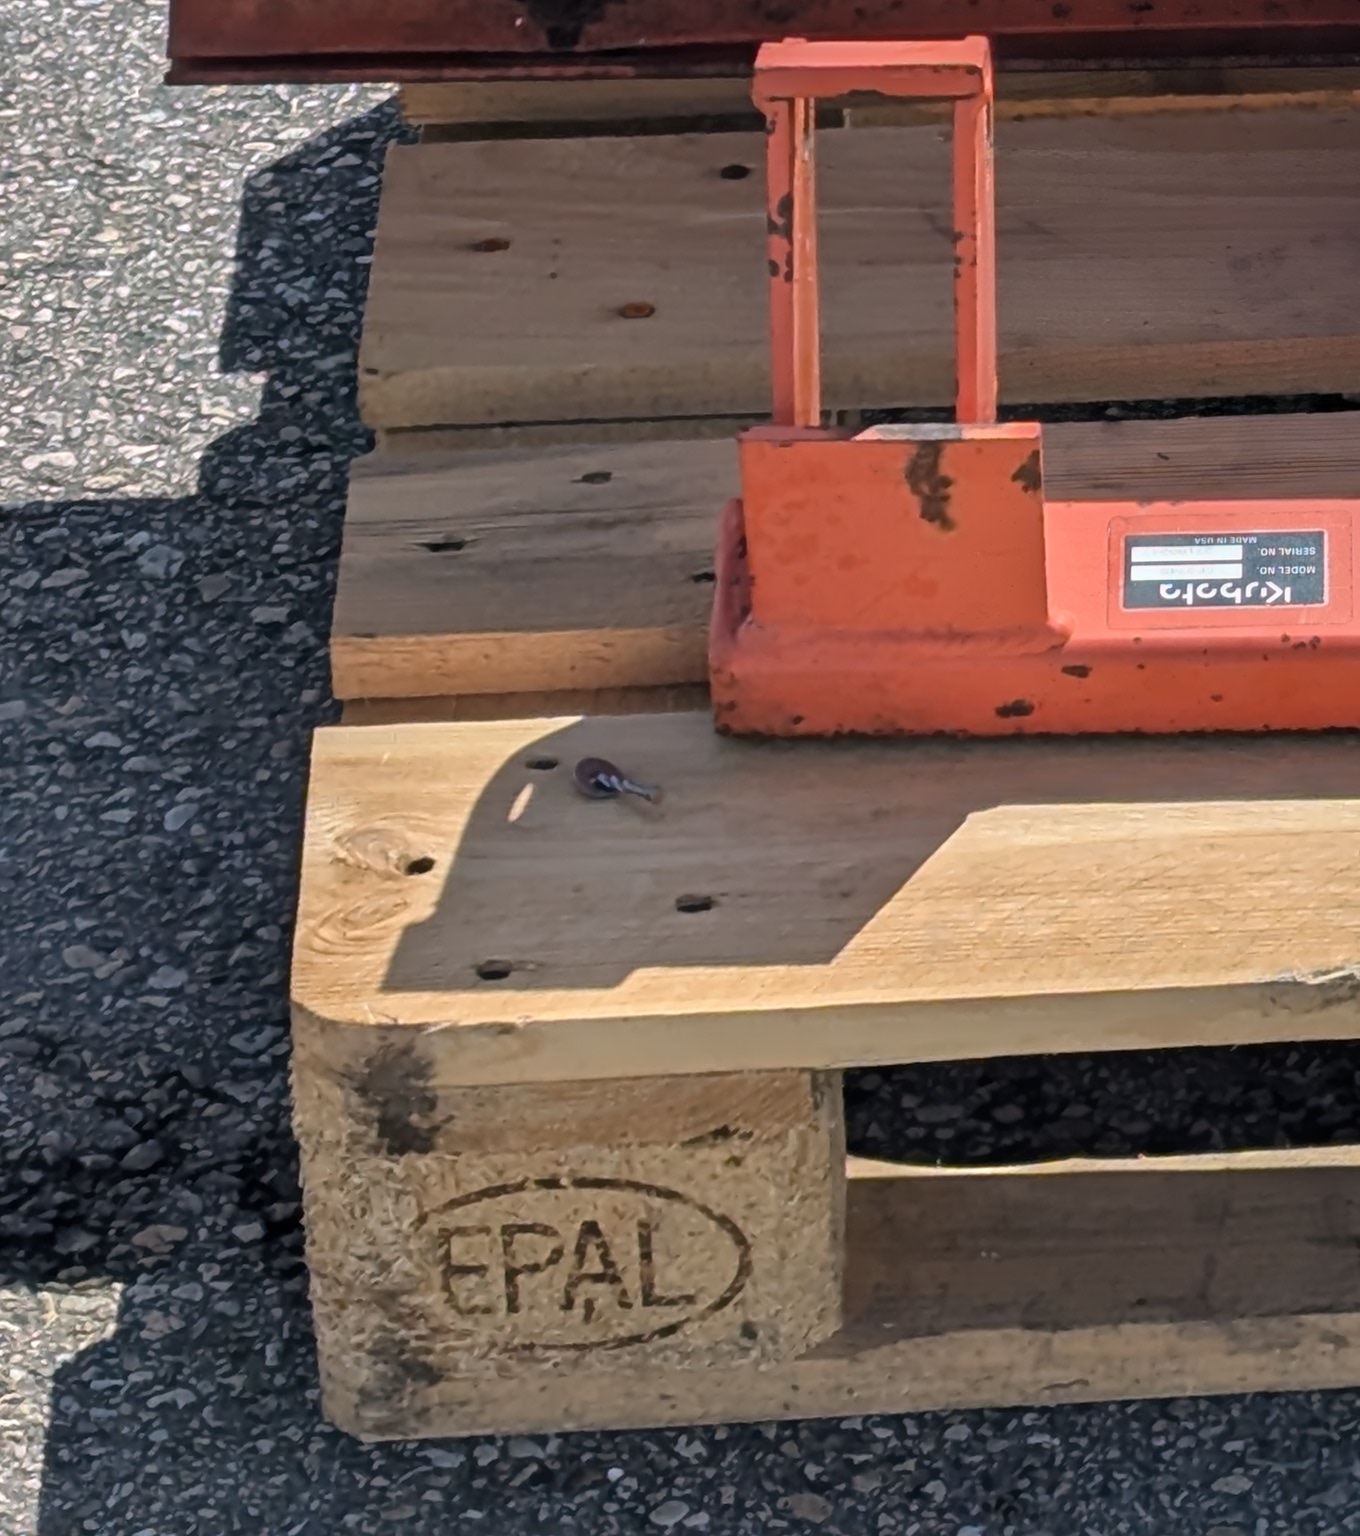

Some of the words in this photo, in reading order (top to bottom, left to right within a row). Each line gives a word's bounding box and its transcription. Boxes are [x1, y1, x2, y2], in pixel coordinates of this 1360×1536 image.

[1230, 536, 1257, 544] MADE
[1257, 547, 1275, 556] NO.
[1278, 547, 1316, 556] SERIAL
[1257, 566, 1275, 575] NO.
[1278, 566, 1316, 575] MODEL
[1159, 581, 1291, 605] Kubota
[437, 1220, 698, 1316] EPAL
